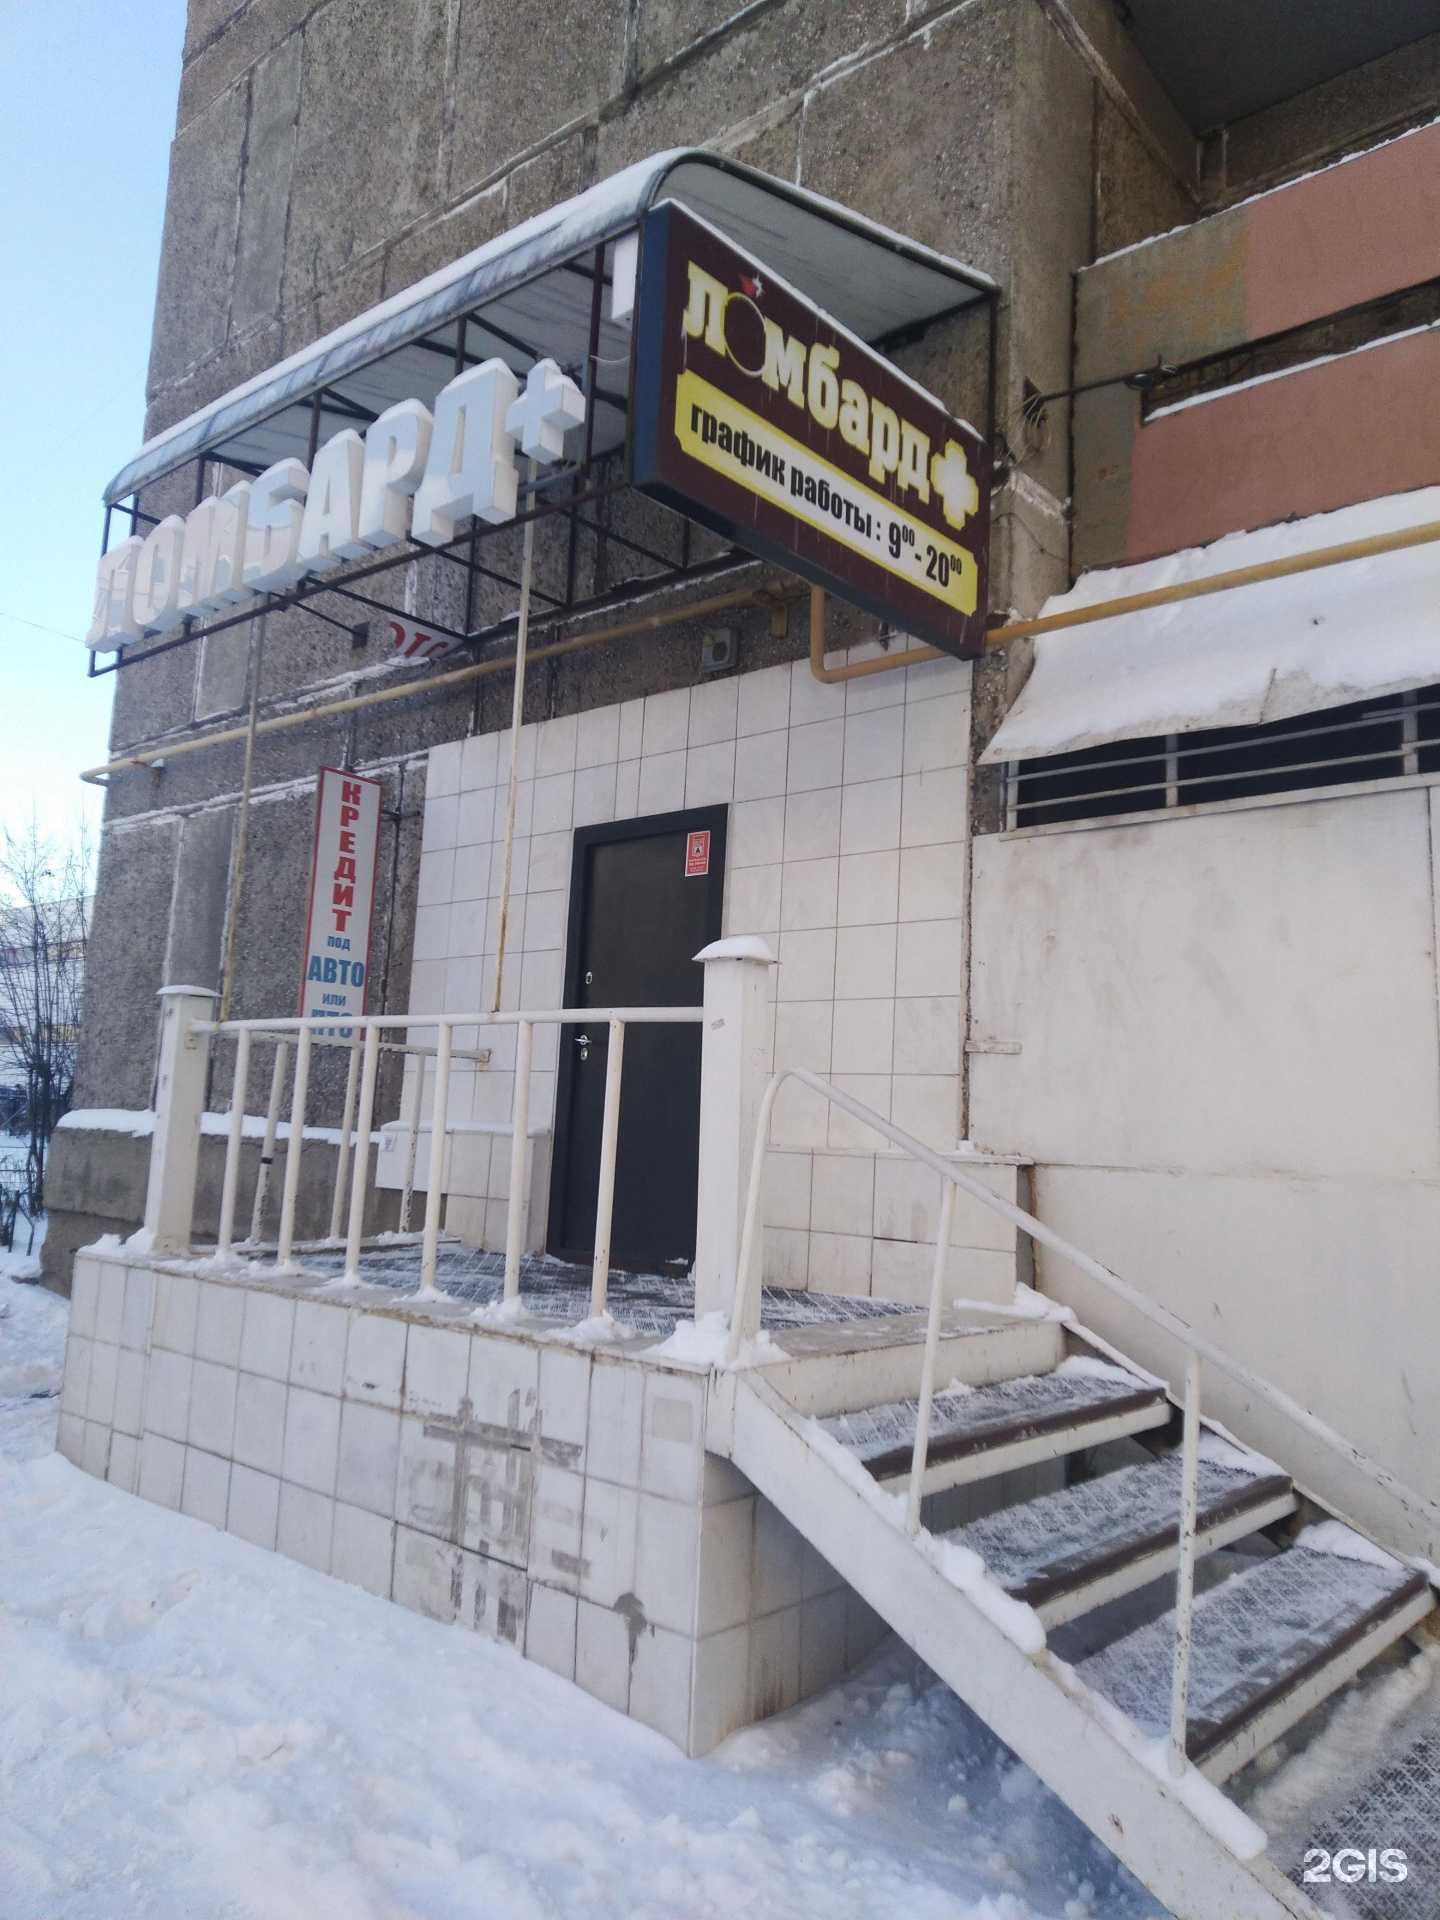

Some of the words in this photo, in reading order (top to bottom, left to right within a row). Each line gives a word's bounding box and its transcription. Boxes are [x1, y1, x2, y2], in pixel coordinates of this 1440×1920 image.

[690, 403, 786, 487] график
[332, 780, 362, 933] КРЕДИТ
[307, 955, 365, 988] АВТО
